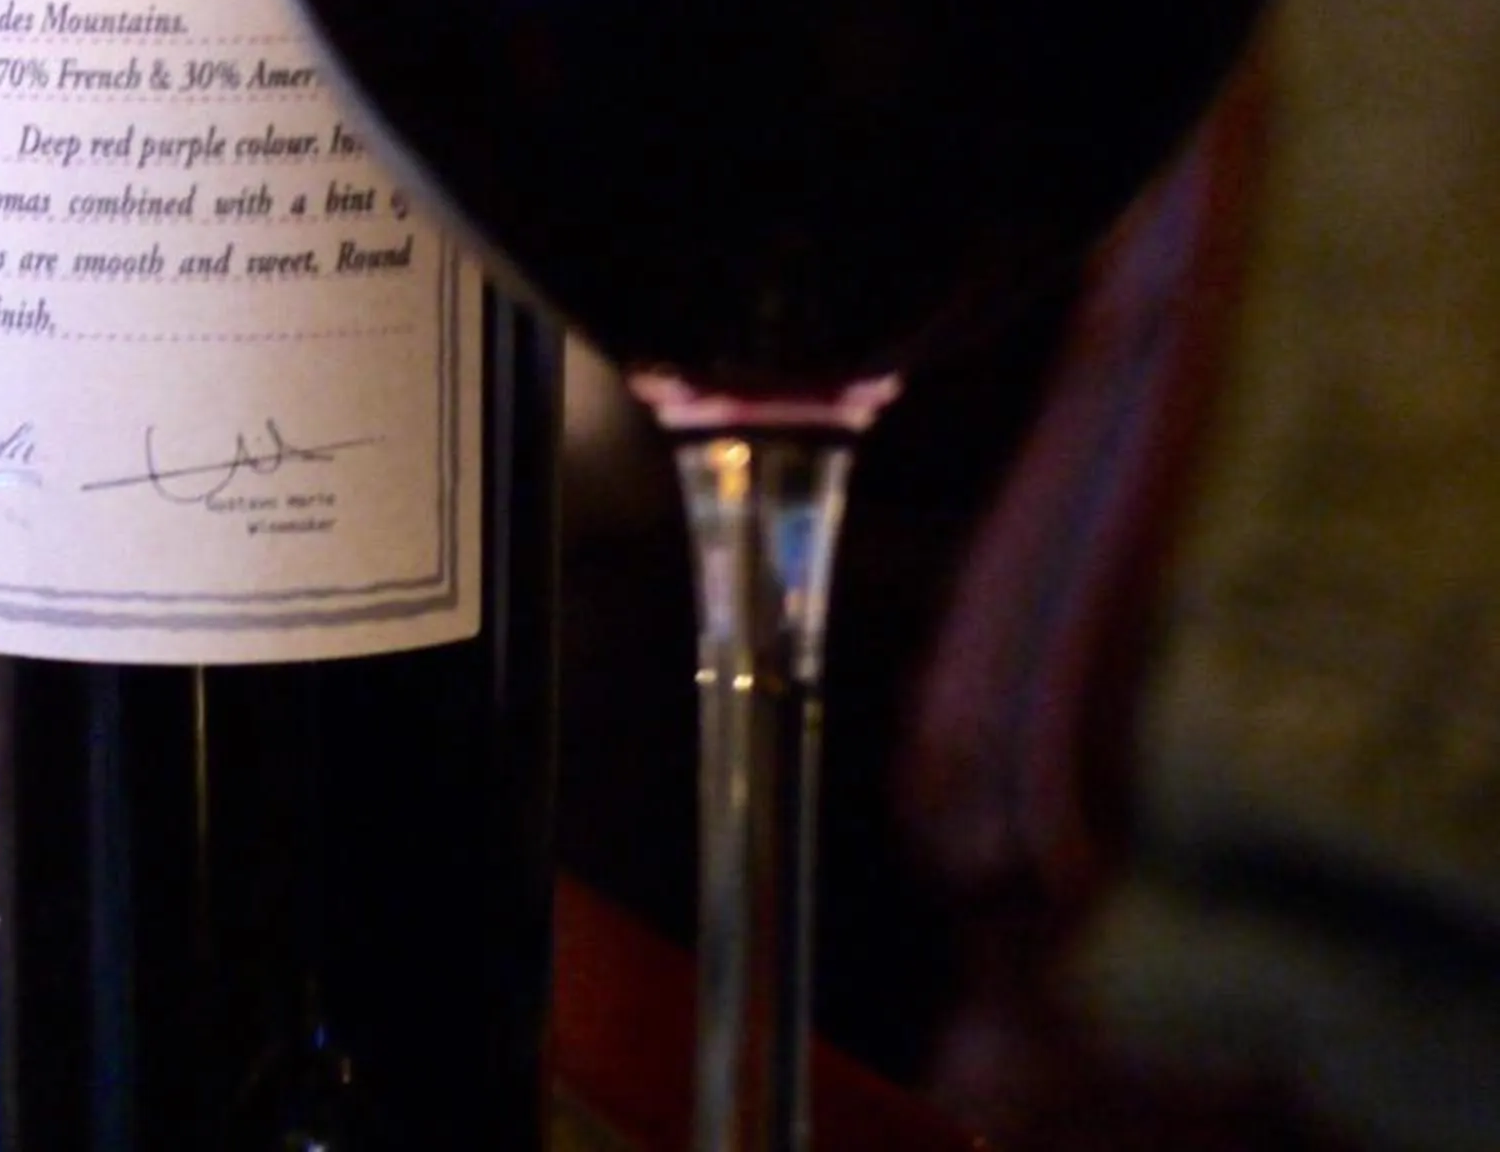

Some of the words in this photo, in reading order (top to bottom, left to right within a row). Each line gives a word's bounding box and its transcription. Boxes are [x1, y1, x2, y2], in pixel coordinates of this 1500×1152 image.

[40, 1, 190, 35] Mountains.
[56, 55, 143, 90] French
[150, 58, 172, 91] &
[178, 58, 243, 92] 30%
[19, 122, 82, 168] Deep
[90, 123, 136, 158] red
[137, 123, 227, 170] purple
[234, 123, 320, 159] colour.
[68, 181, 197, 217] combined
[214, 184, 274, 217] with
[289, 194, 308, 217] a
[324, 179, 378, 214] hint
[18, 249, 59, 274] are
[72, 241, 166, 276] smooth
[178, 240, 235, 275] and
[245, 247, 320, 276] sweet.
[334, 233, 415, 275] Round
